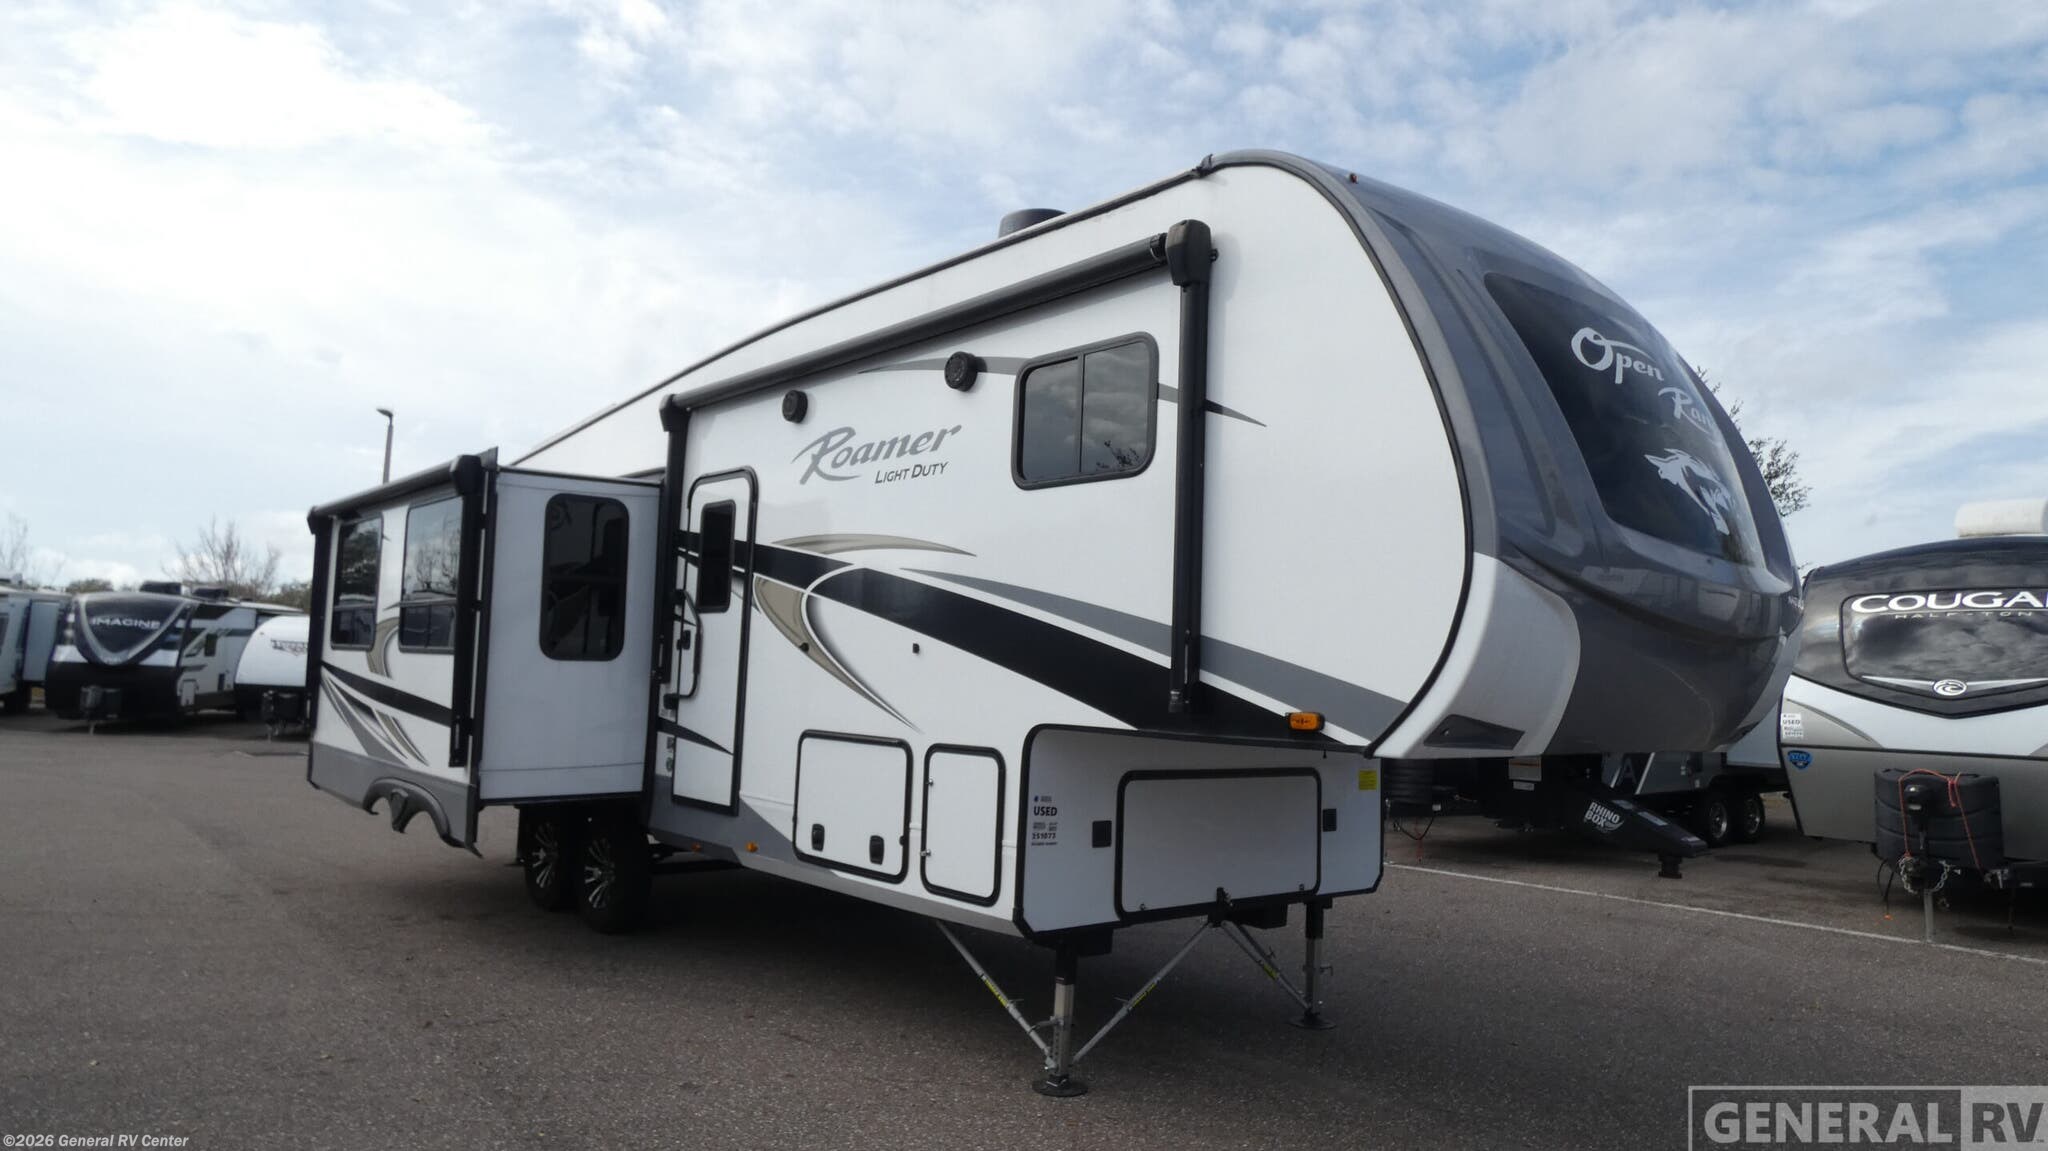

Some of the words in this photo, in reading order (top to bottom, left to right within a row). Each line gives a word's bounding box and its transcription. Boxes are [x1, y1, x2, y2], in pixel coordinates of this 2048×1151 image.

[1571, 327, 1664, 384] Open
[1658, 387, 1714, 434] Ran
[791, 425, 962, 485] Roamer
[875, 468, 910, 484] LIGHT
[911, 462, 949, 478] DUTY
[1851, 591, 2048, 613] COUGA
[91, 617, 161, 629] IMAGINE
[1033, 806, 1058, 816] USED
[1584, 810, 1606, 827] BOX
[1589, 802, 1620, 824] RHINO
